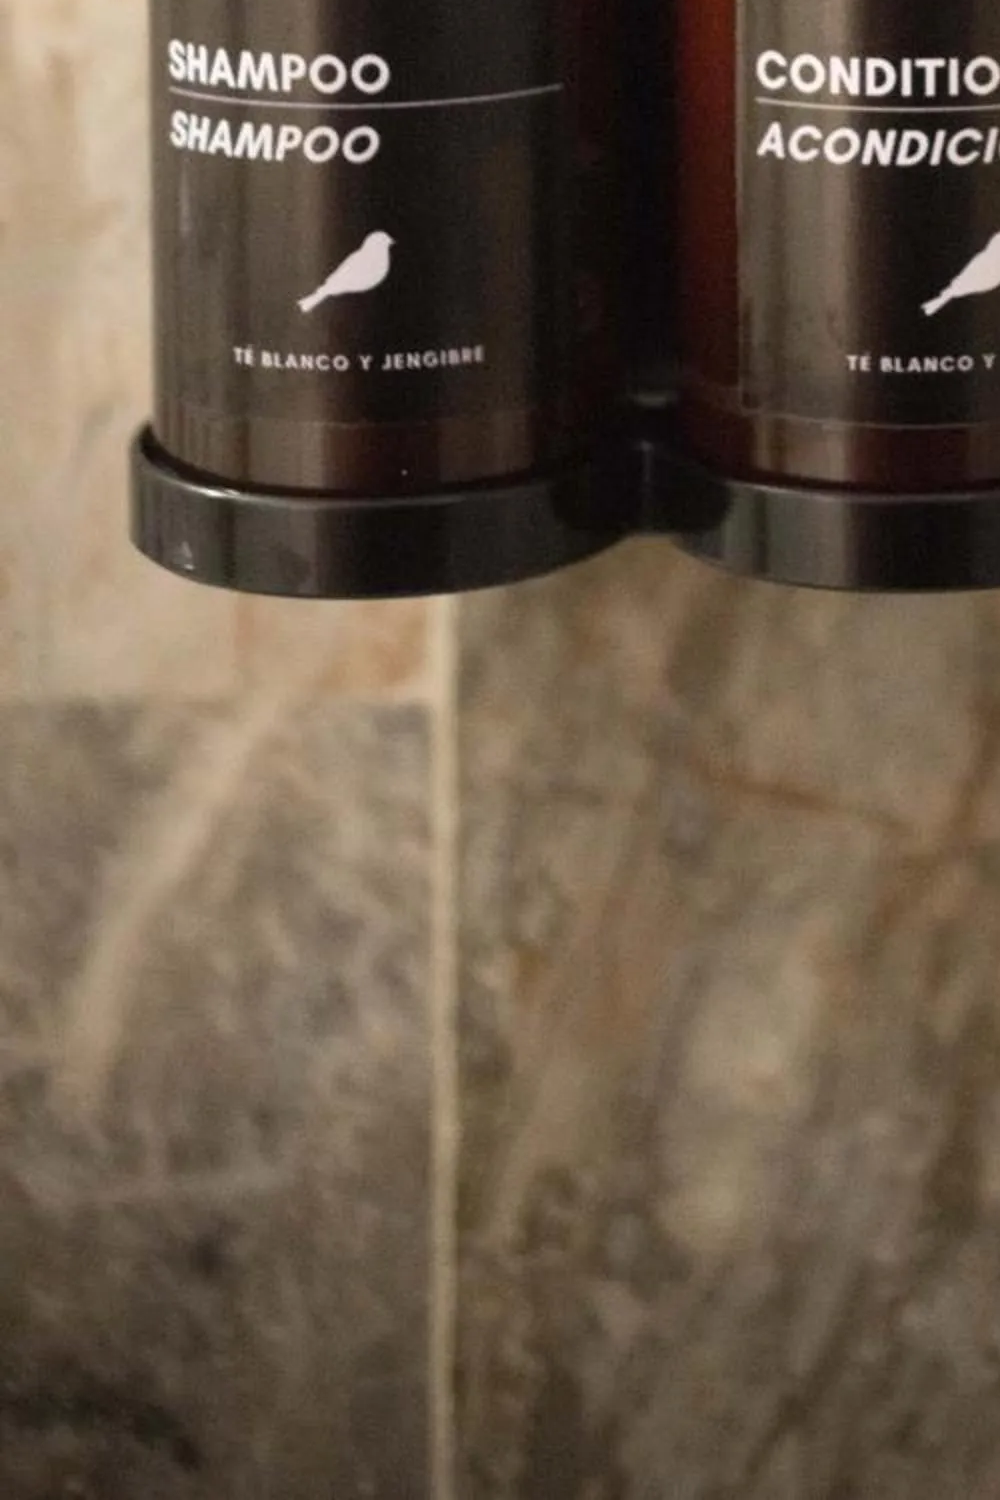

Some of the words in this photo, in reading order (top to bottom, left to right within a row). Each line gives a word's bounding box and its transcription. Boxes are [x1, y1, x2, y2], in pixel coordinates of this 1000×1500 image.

[168, 37, 392, 95] SHAMPOO
[168, 109, 382, 164] SHAMPOO
[233, 343, 254, 366] TÉ
[260, 350, 350, 372] BLANCO
[359, 355, 373, 371] Y
[381, 345, 485, 371] JENGIBRE
[879, 354, 975, 374] BLANCO
[981, 353, 996, 369] Y
